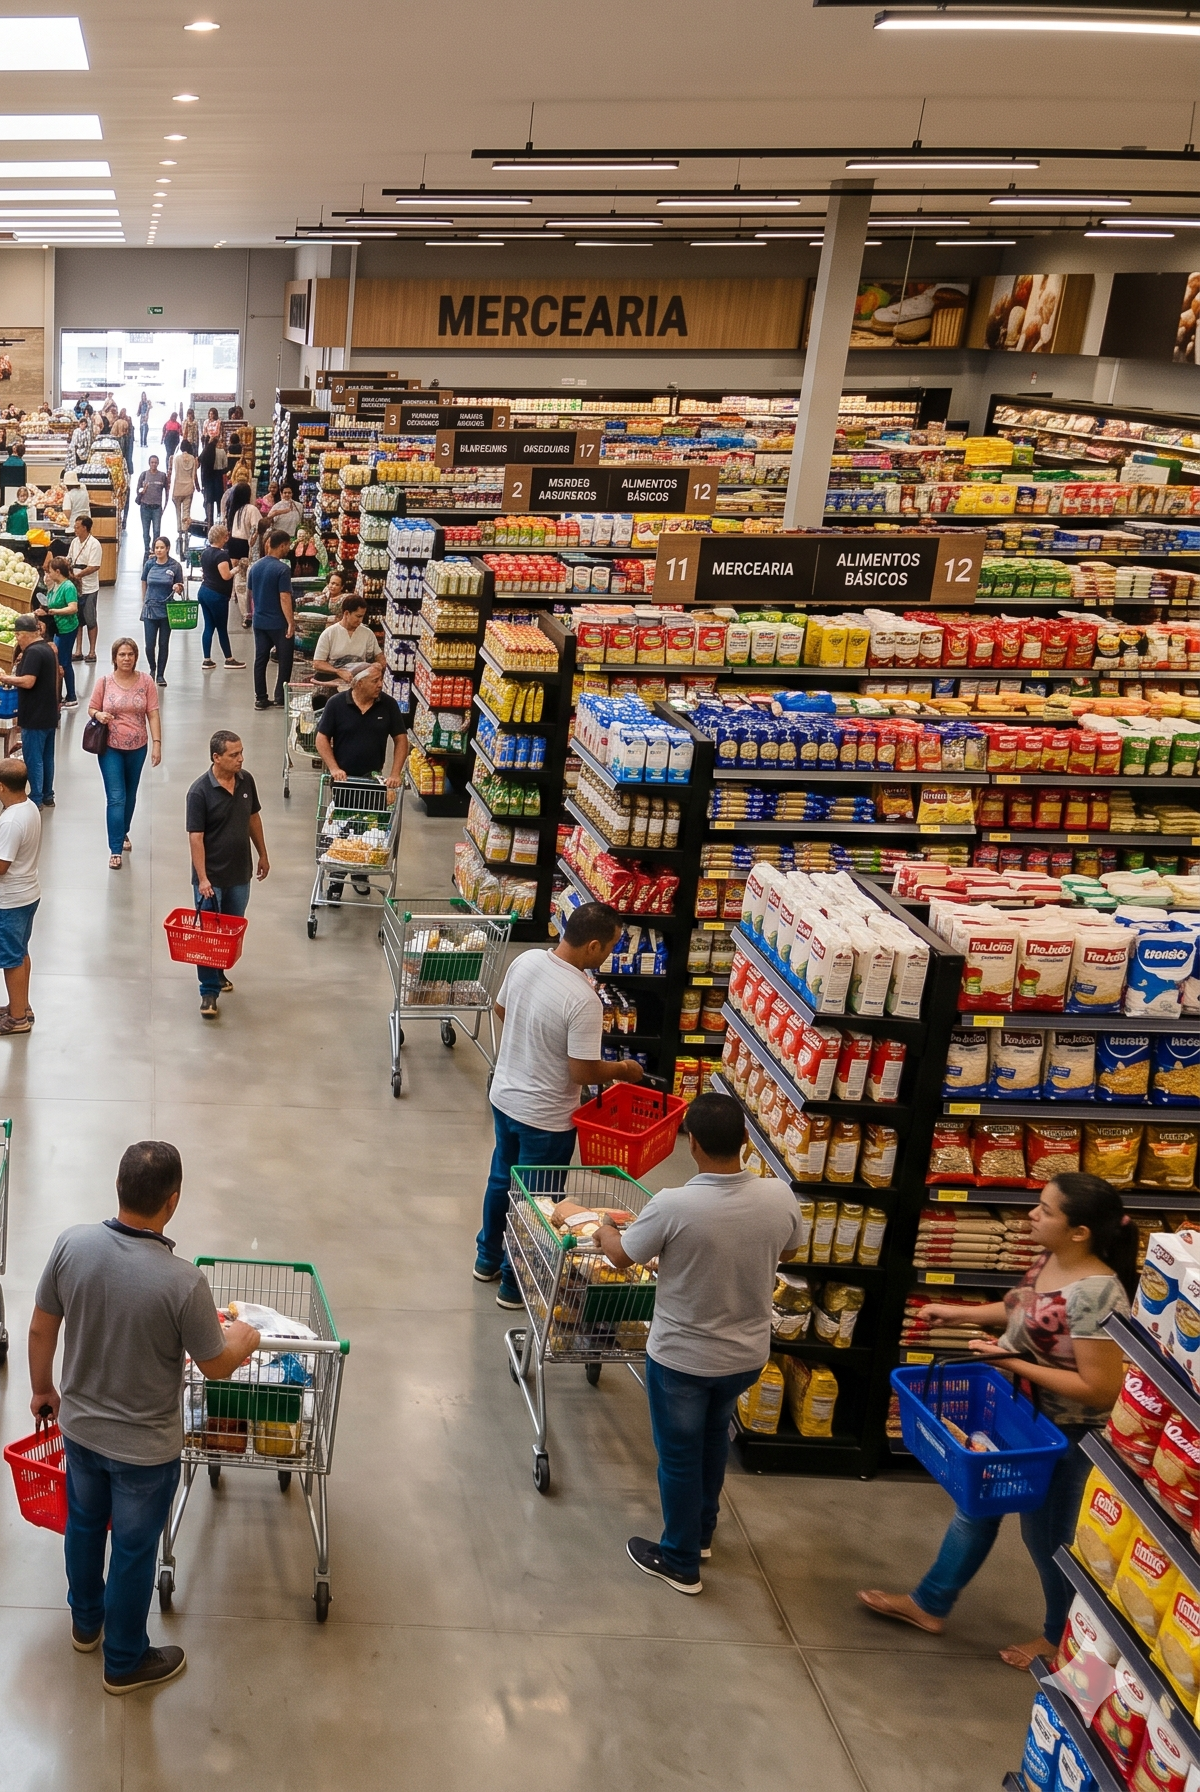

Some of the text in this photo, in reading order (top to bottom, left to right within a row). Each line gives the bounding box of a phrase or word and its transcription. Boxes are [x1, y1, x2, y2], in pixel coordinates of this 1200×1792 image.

[438, 295, 688, 337] MERCEARIA
[579, 444, 595, 458] 17
[511, 481, 523, 498] 2
[621, 479, 678, 489] ALIMENTOS
[693, 483, 712, 500] 12
[627, 490, 669, 502] BÁSICOS
[836, 552, 921, 567] ALIMENTOS
[665, 557, 688, 581] 11
[712, 562, 794, 576] MERCEARIA
[944, 558, 973, 583] 12
[844, 570, 908, 586] BÁSICOS
